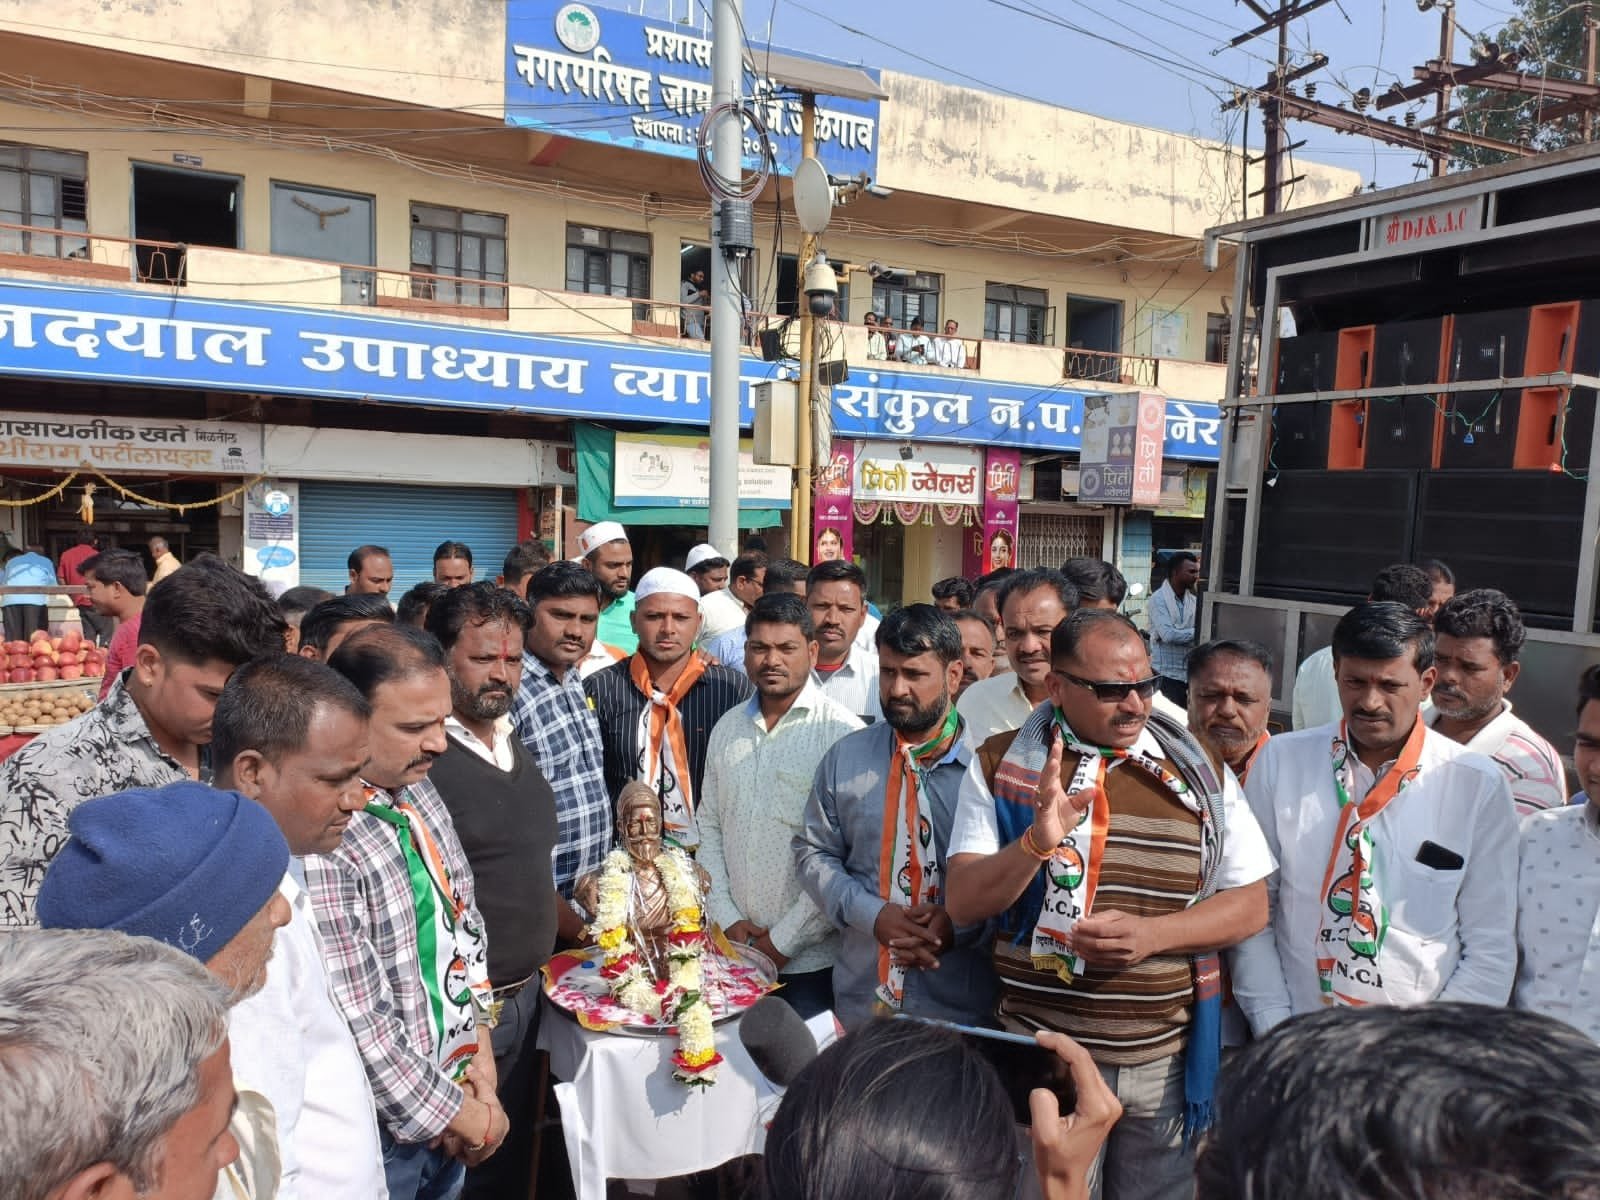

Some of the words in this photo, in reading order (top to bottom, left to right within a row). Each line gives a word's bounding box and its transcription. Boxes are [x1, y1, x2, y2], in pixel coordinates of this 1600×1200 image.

[644, 26, 712, 70] प्रशास
[513, 44, 651, 110] नगरपरिषद
[300, 329, 588, 395] उपाध्याय
[835, 373, 972, 435] संकुल
[1164, 403, 1221, 445] नेर
[139, 425, 189, 443] खते
[911, 461, 977, 494] ज्वेलर्स
